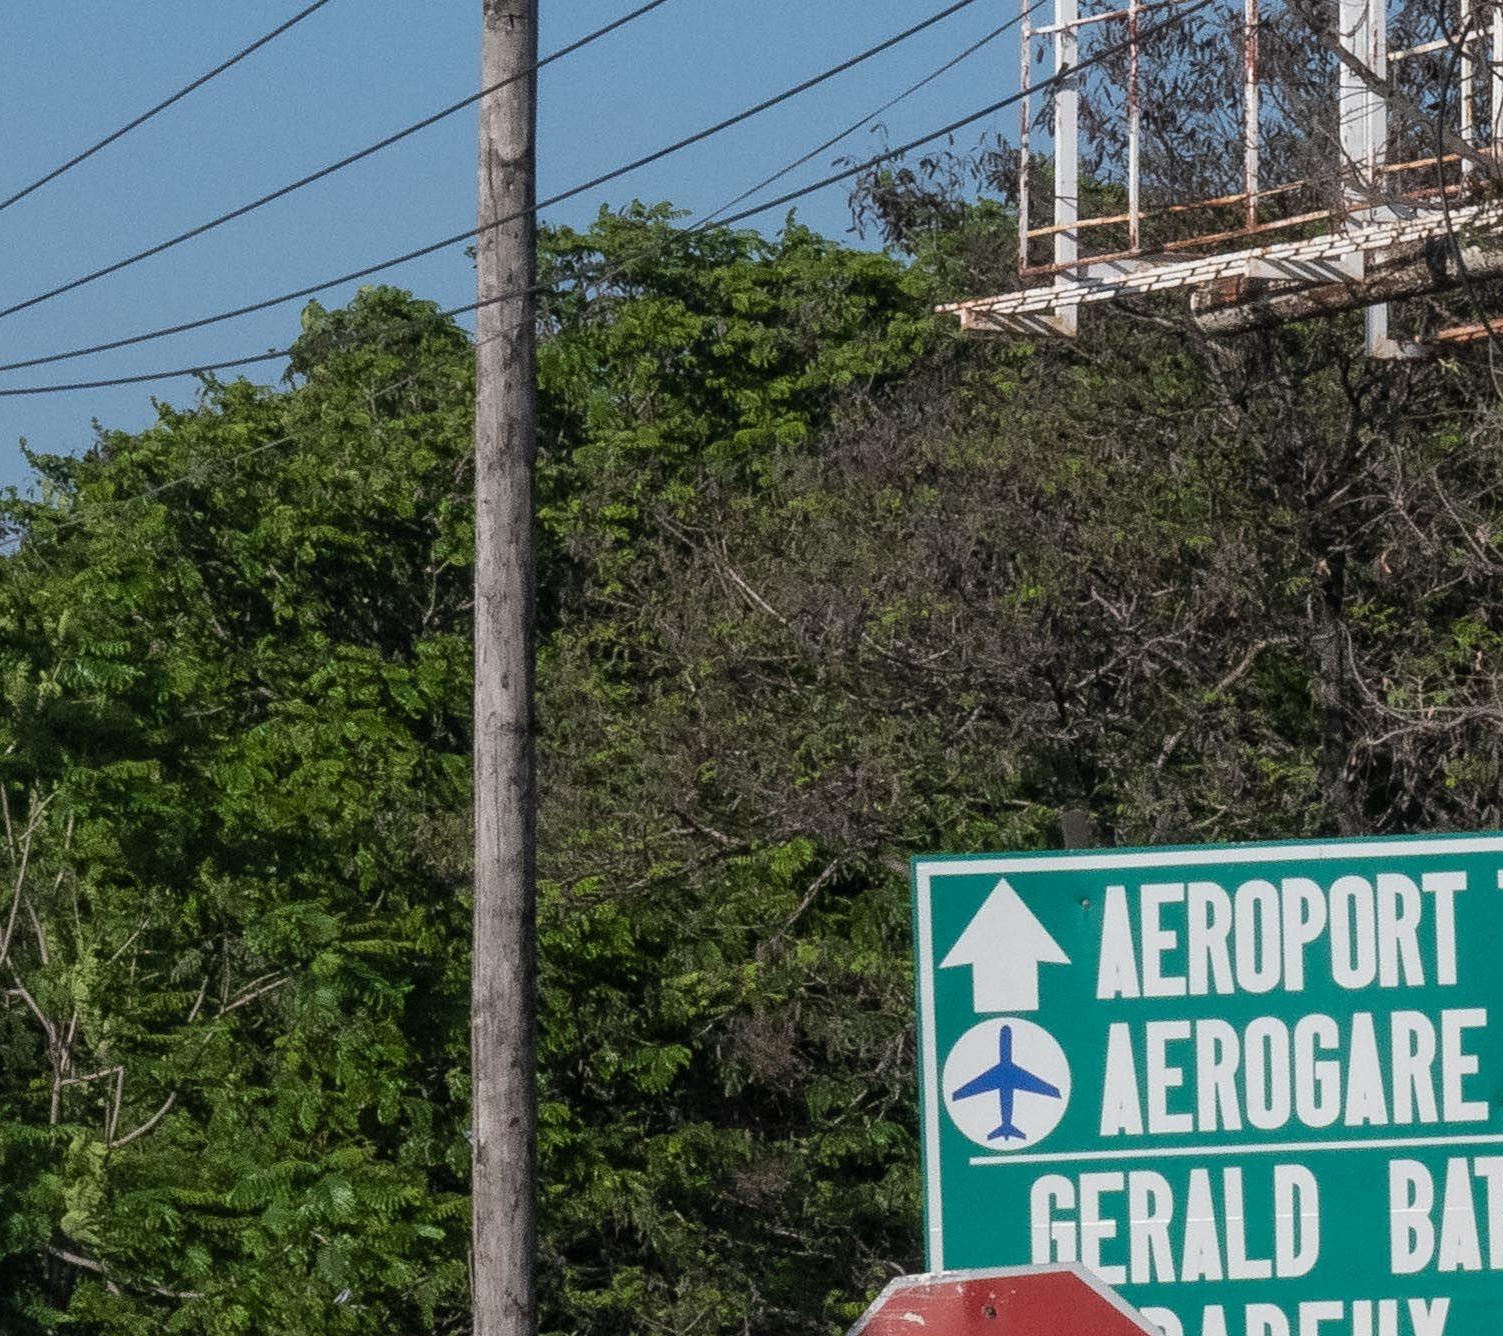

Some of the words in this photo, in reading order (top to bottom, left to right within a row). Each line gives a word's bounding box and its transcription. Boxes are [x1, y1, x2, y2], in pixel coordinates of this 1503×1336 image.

[1097, 872, 1467, 999] AEROPORT
[1100, 1009, 1488, 1136] AEROGARE
[1030, 1164, 1320, 1284] GERALD
